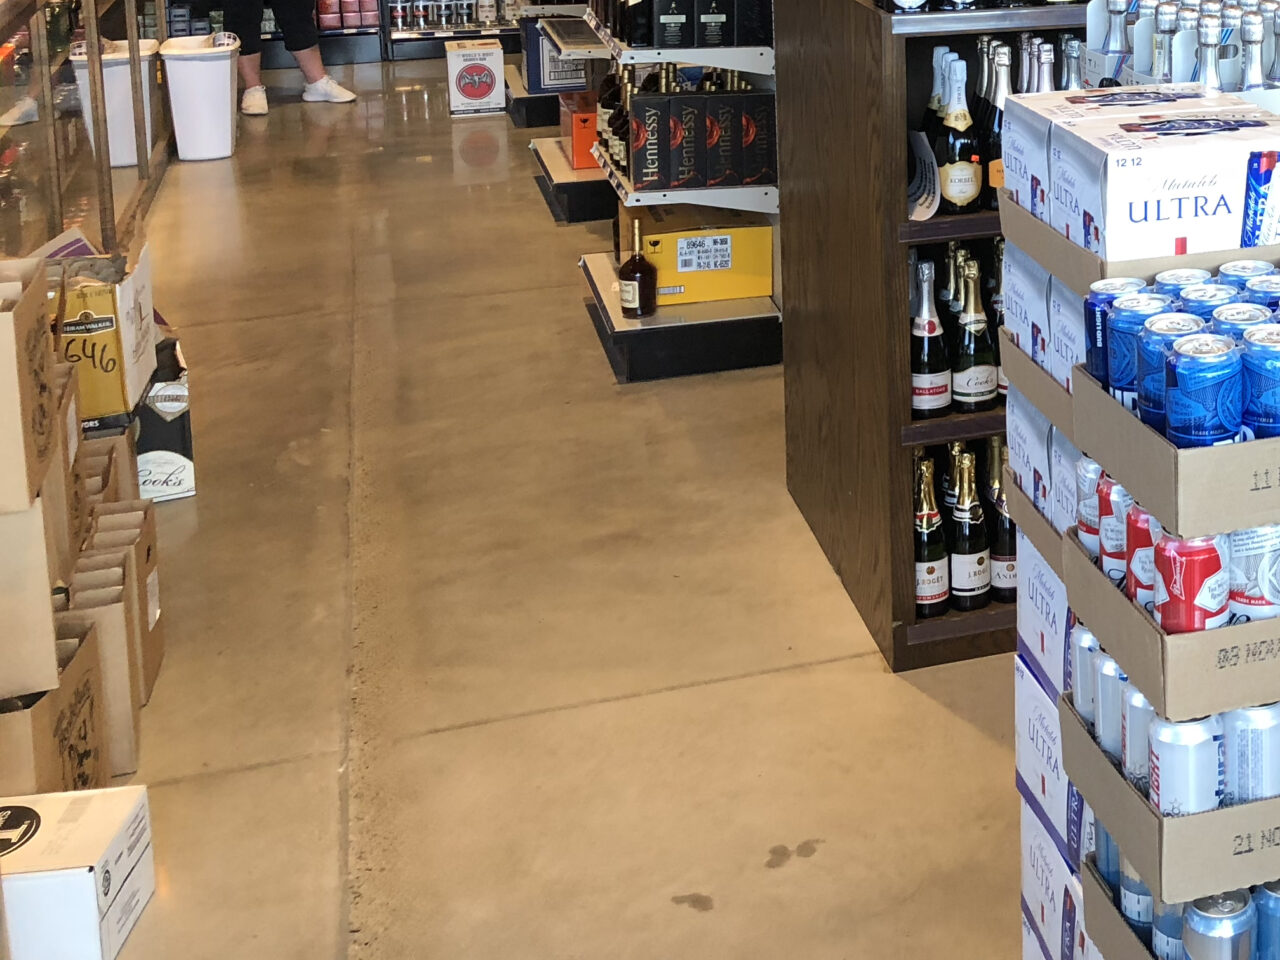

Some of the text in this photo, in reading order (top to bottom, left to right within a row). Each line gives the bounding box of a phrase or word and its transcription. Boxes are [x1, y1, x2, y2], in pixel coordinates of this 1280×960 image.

[643, 106, 661, 181] Hennessy
[678, 105, 698, 180] Hennessy
[1003, 150, 1030, 182] ULTRA
[1116, 156, 1143, 168] 12 12
[1052, 179, 1081, 217] ULTRA
[1128, 193, 1233, 224] ULTRA
[1004, 294, 1030, 328] ULTRA
[64, 338, 117, 373] 646
[966, 375, 994, 387] Cook's
[1251, 471, 1273, 492] 11
[1055, 487, 1076, 521] ULTR
[1027, 577, 1059, 635] ULTRA
[1028, 718, 1061, 781] ULTRA
[1232, 834, 1254, 856] 21
[1029, 847, 1056, 913] ULTRA
